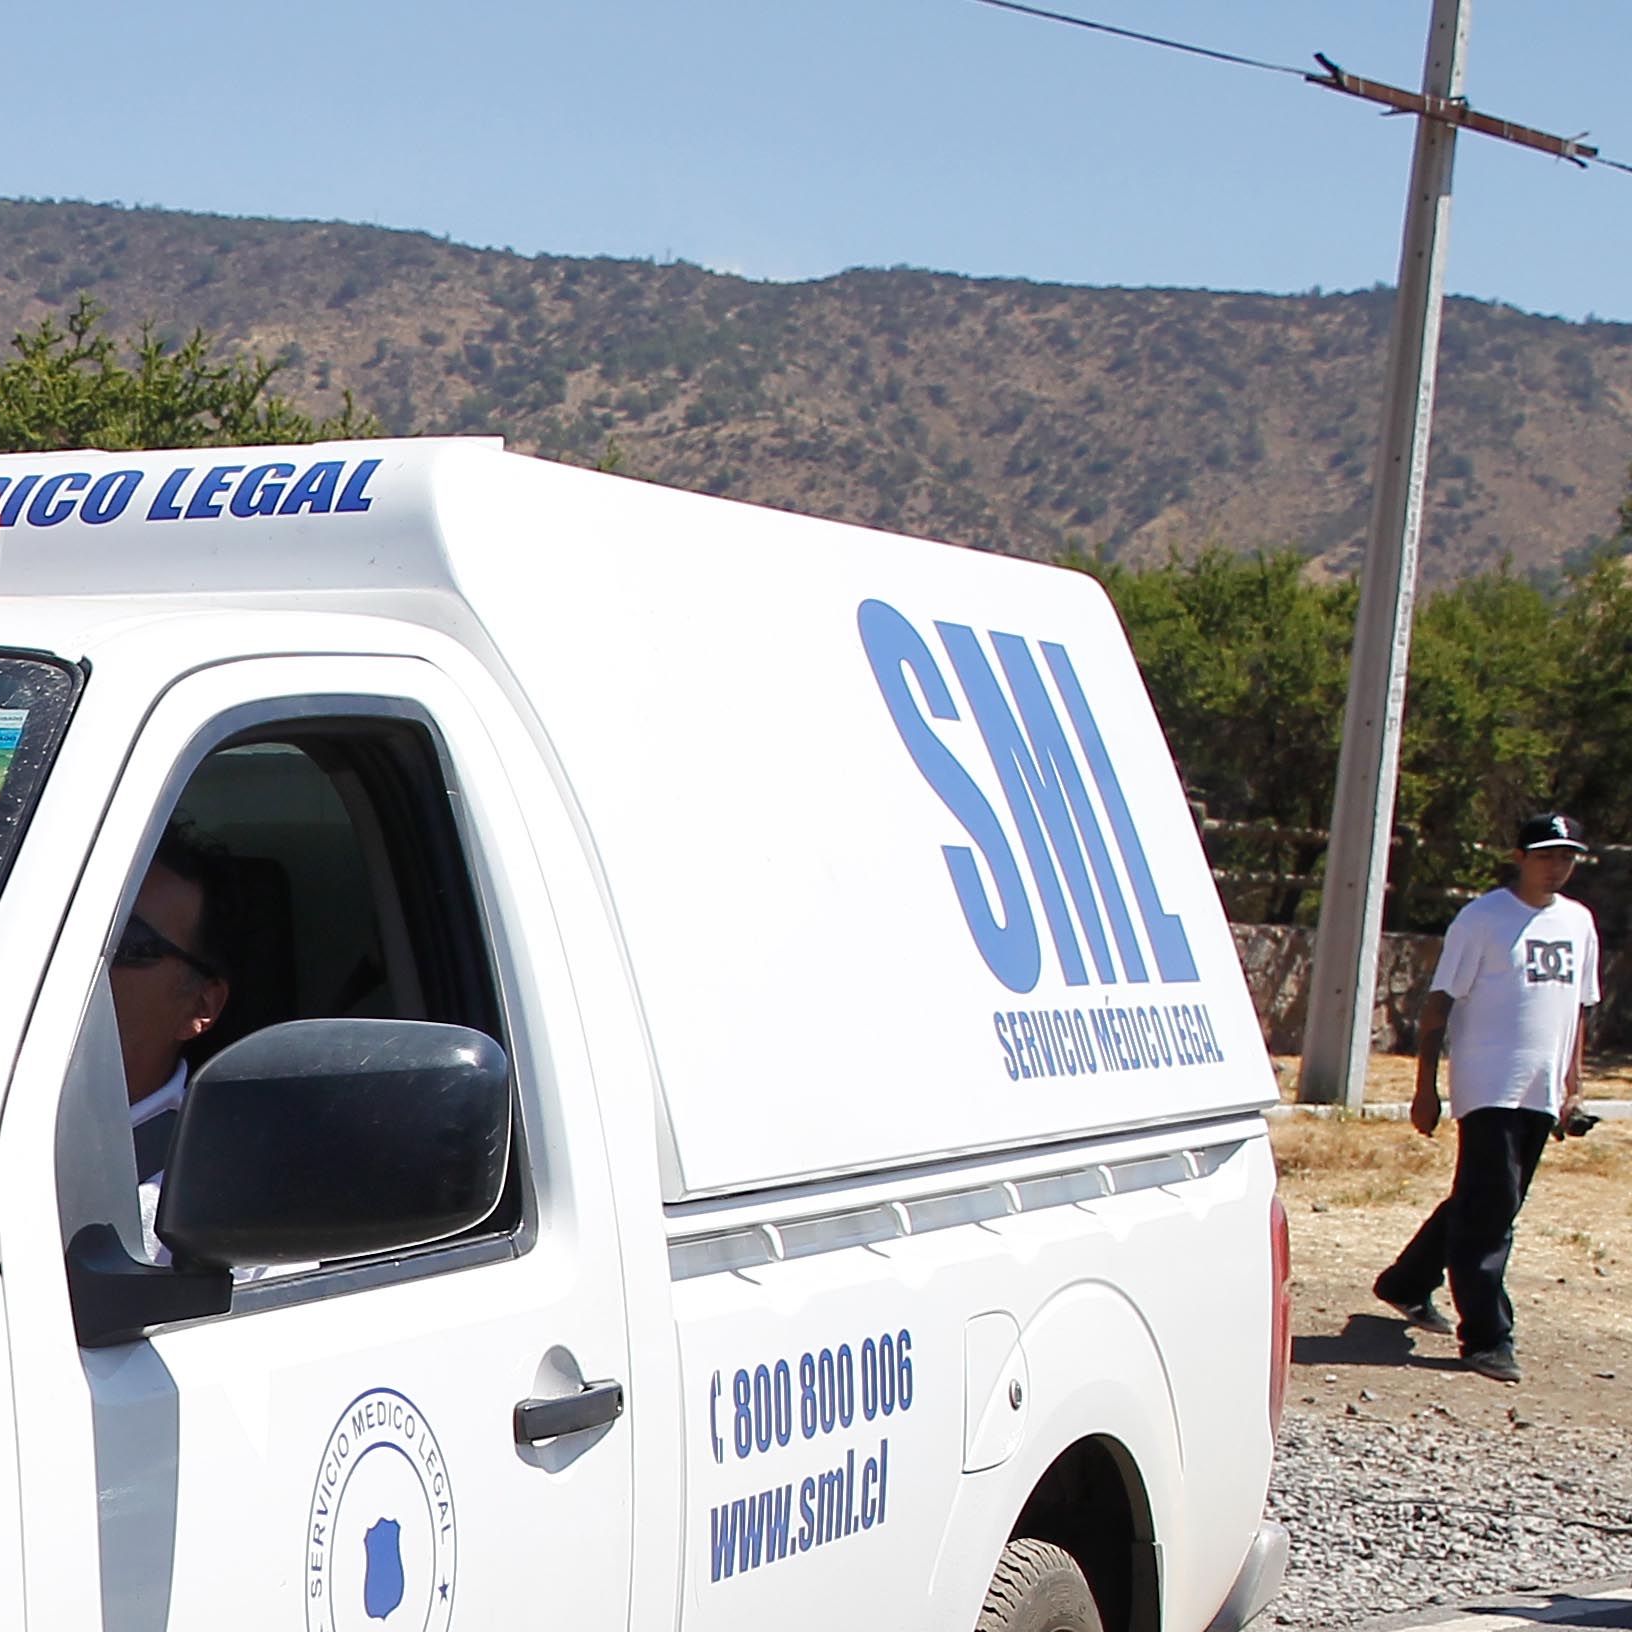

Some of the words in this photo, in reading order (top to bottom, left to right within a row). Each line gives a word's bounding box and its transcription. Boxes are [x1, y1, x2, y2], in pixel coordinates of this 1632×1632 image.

[146, 459, 384, 521] LEGAL
[857, 598, 1201, 994] SML
[993, 1007, 1098, 1081] SERVICIO
[1163, 1003, 1225, 1066] LEGAL
[733, 1359, 793, 1459] 800
[800, 1343, 855, 1440] 800
[861, 1328, 914, 1421] 006
[310, 1432, 350, 1599] SERVICIO
[351, 1400, 416, 1441] MEDICO
[418, 1432, 452, 1546] LEGAL
[710, 1438, 888, 1585] www.sml.cl
